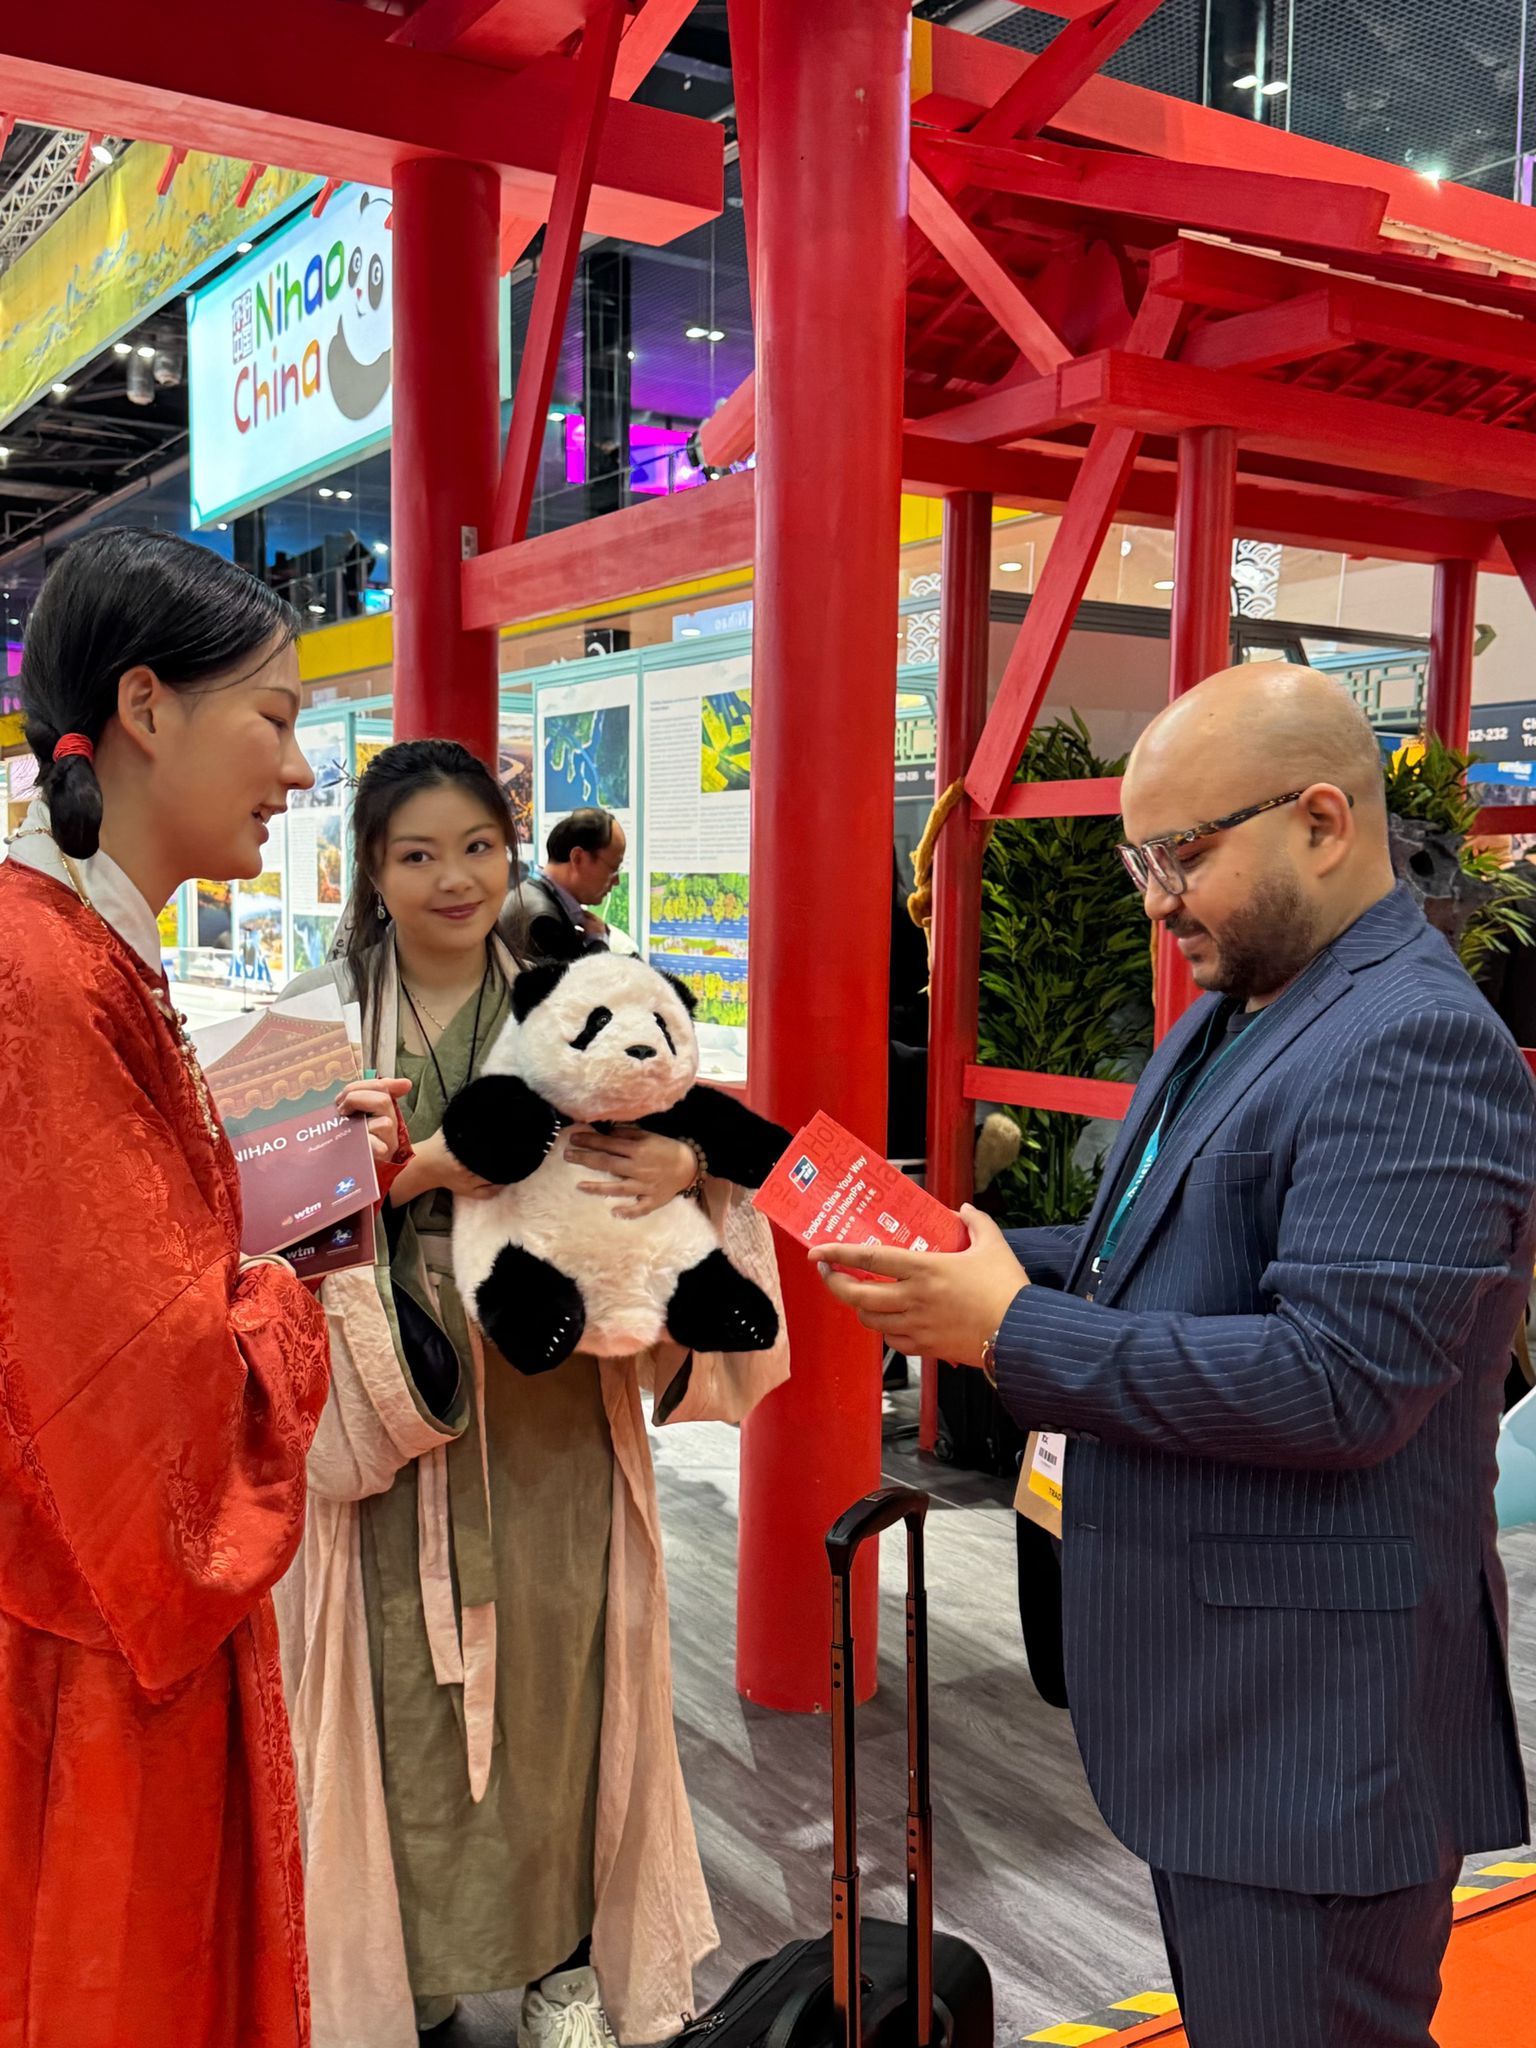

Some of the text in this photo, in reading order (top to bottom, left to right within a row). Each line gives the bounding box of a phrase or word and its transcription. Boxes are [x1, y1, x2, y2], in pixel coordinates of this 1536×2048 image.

[256, 240, 345, 350] Nihao
[234, 339, 321, 435] China
[295, 1116, 350, 1142] CHINA
[293, 1201, 322, 1220] wtm
[802, 1155, 868, 1241] Explore China Your Way
[824, 1178, 867, 1233] with UnionPay
[285, 1245, 316, 1260] wtm
